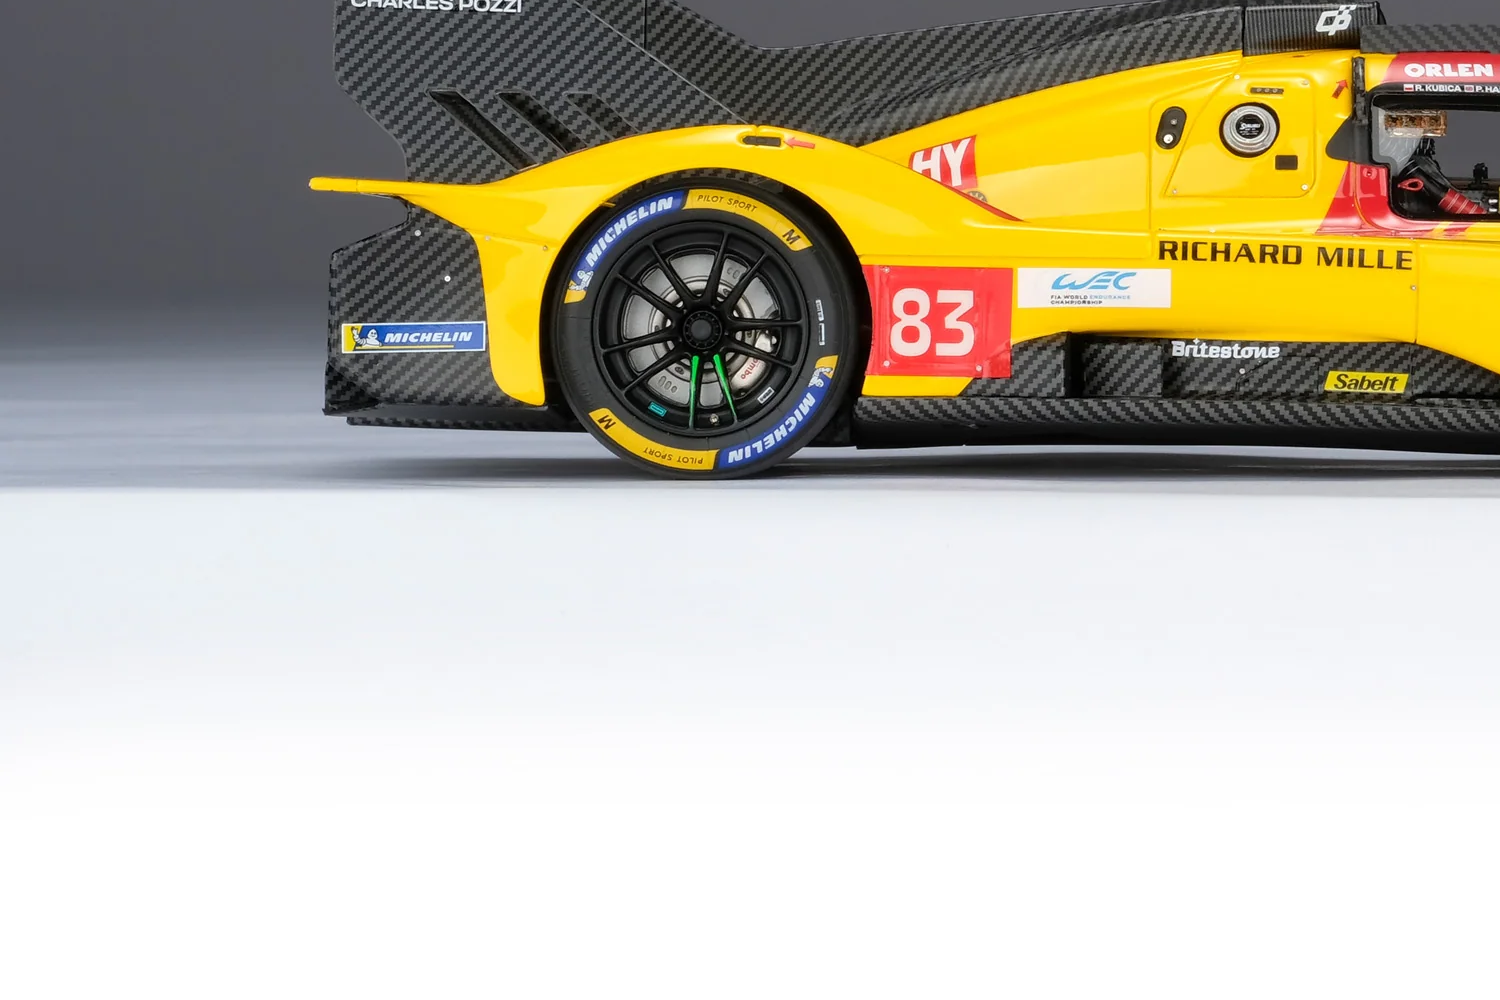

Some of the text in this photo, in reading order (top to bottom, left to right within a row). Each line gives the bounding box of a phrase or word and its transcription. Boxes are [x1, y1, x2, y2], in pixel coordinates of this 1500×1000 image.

[1404, 63, 1494, 78] ORLEN
[912, 137, 971, 187] HY
[696, 193, 758, 213] PILOT SPORT
[584, 195, 674, 268] MICHELIN
[781, 228, 802, 246] M
[1158, 240, 1413, 271] RICHARD MILLE
[1051, 271, 1138, 291] WEC
[889, 287, 975, 358] 83
[384, 331, 473, 343] MICHELIN
[1171, 338, 1281, 359] Britestone
[1334, 373, 1399, 391] Sabelt
[597, 414, 616, 430] M
[728, 392, 816, 464] MICHELIN
[642, 446, 704, 465] PILOT SPORT
